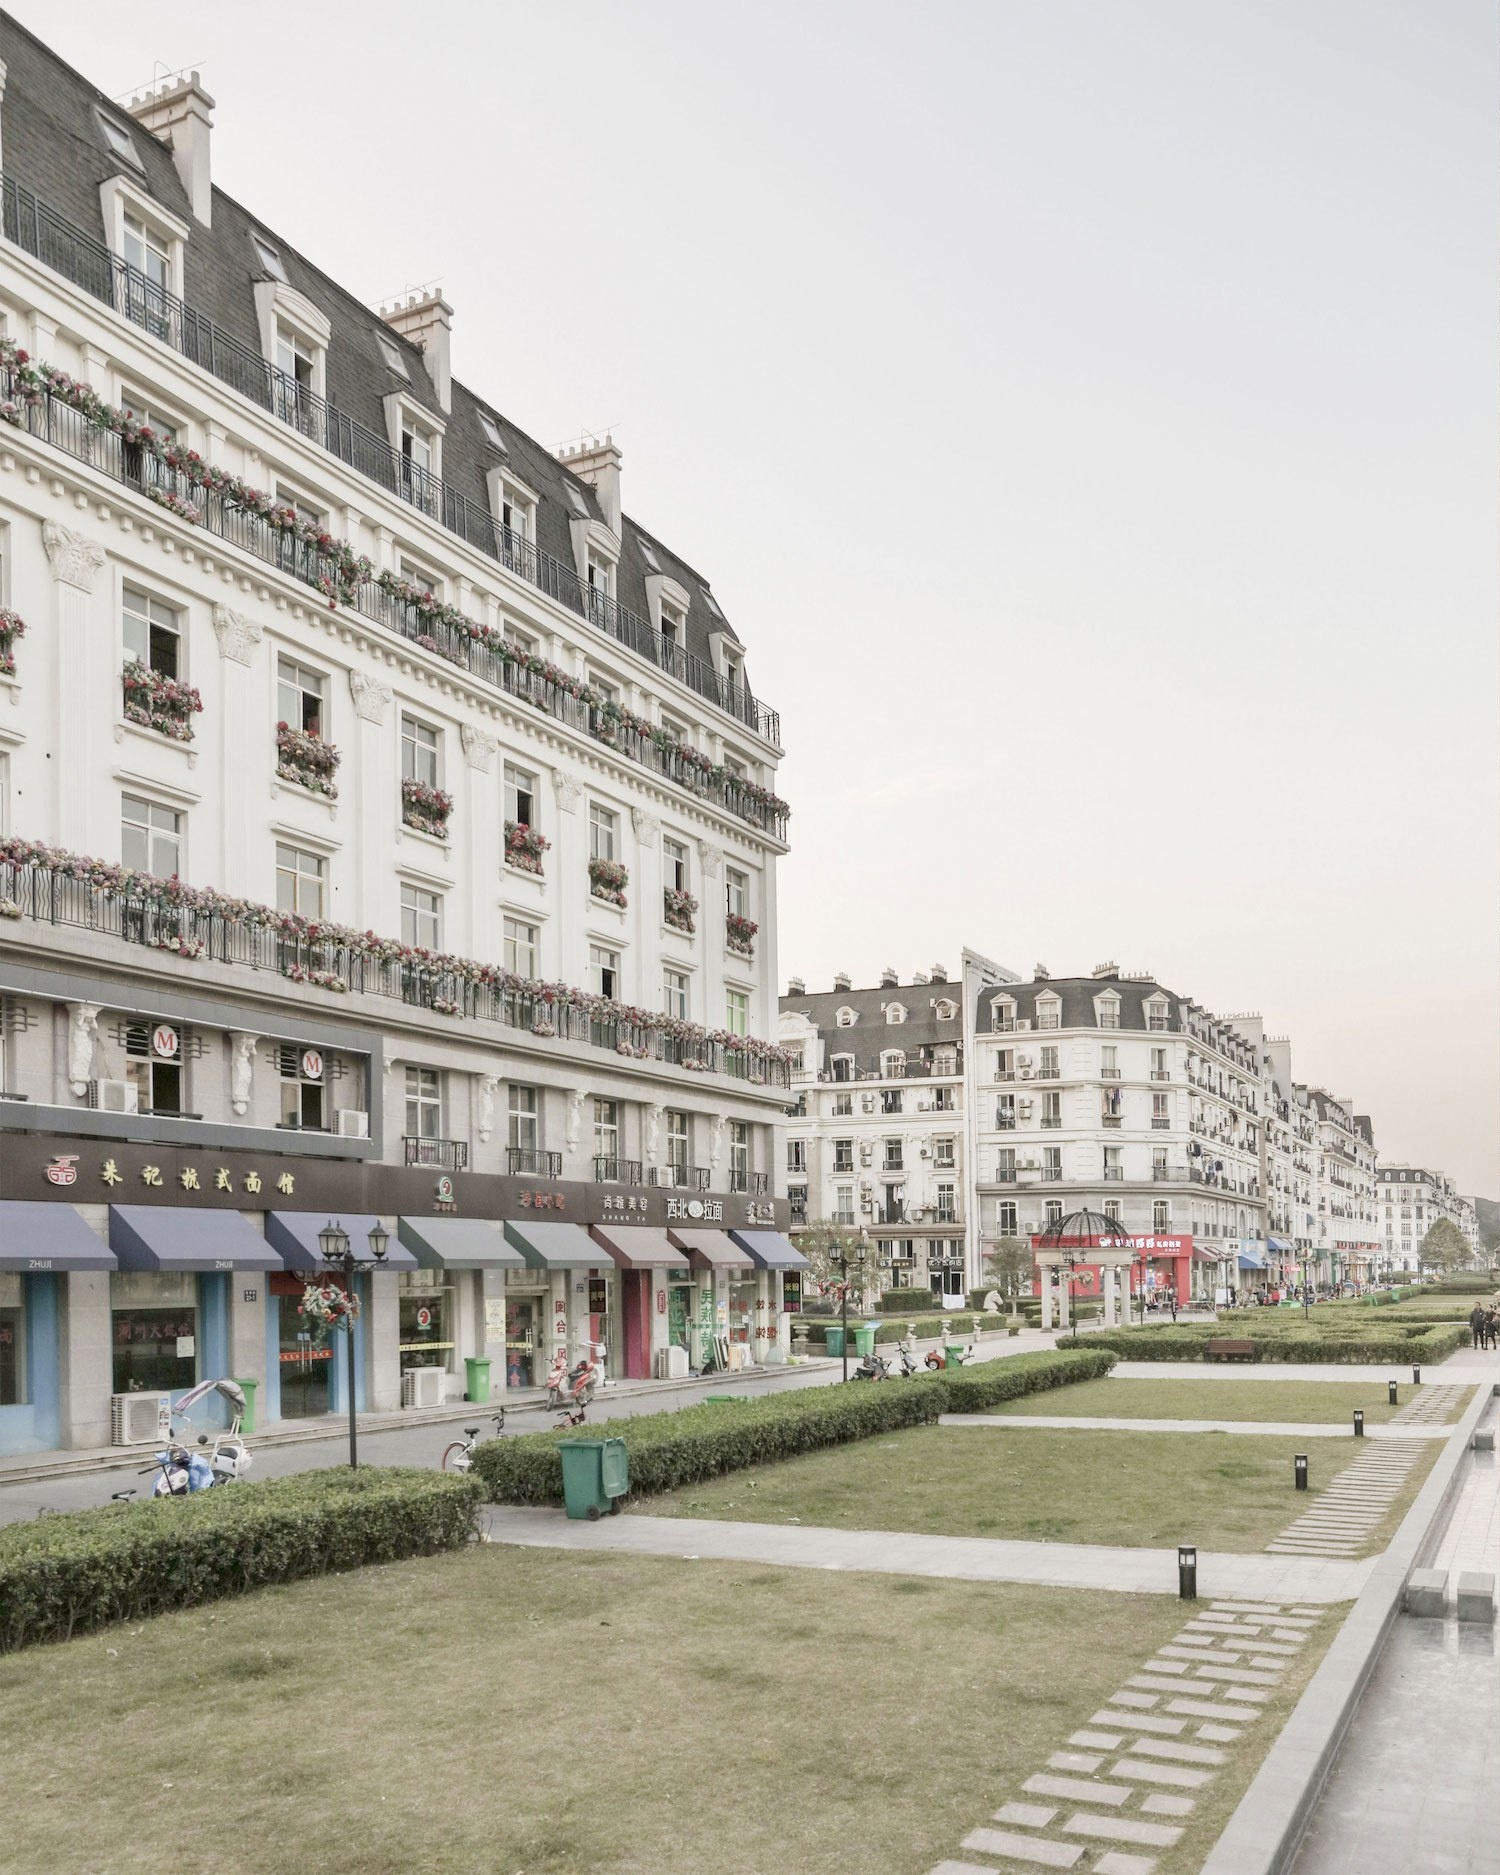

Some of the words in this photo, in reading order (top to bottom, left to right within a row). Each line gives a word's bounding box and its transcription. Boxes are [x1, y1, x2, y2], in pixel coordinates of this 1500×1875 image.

[157, 1031, 175, 1051] M
[306, 1055, 320, 1073] M
[667, 1198, 688, 1219] 西北
[704, 1199, 723, 1222] 拉面
[29, 1260, 52, 1268] ZHUJI
[215, 1260, 233, 1269] ZHUJI
